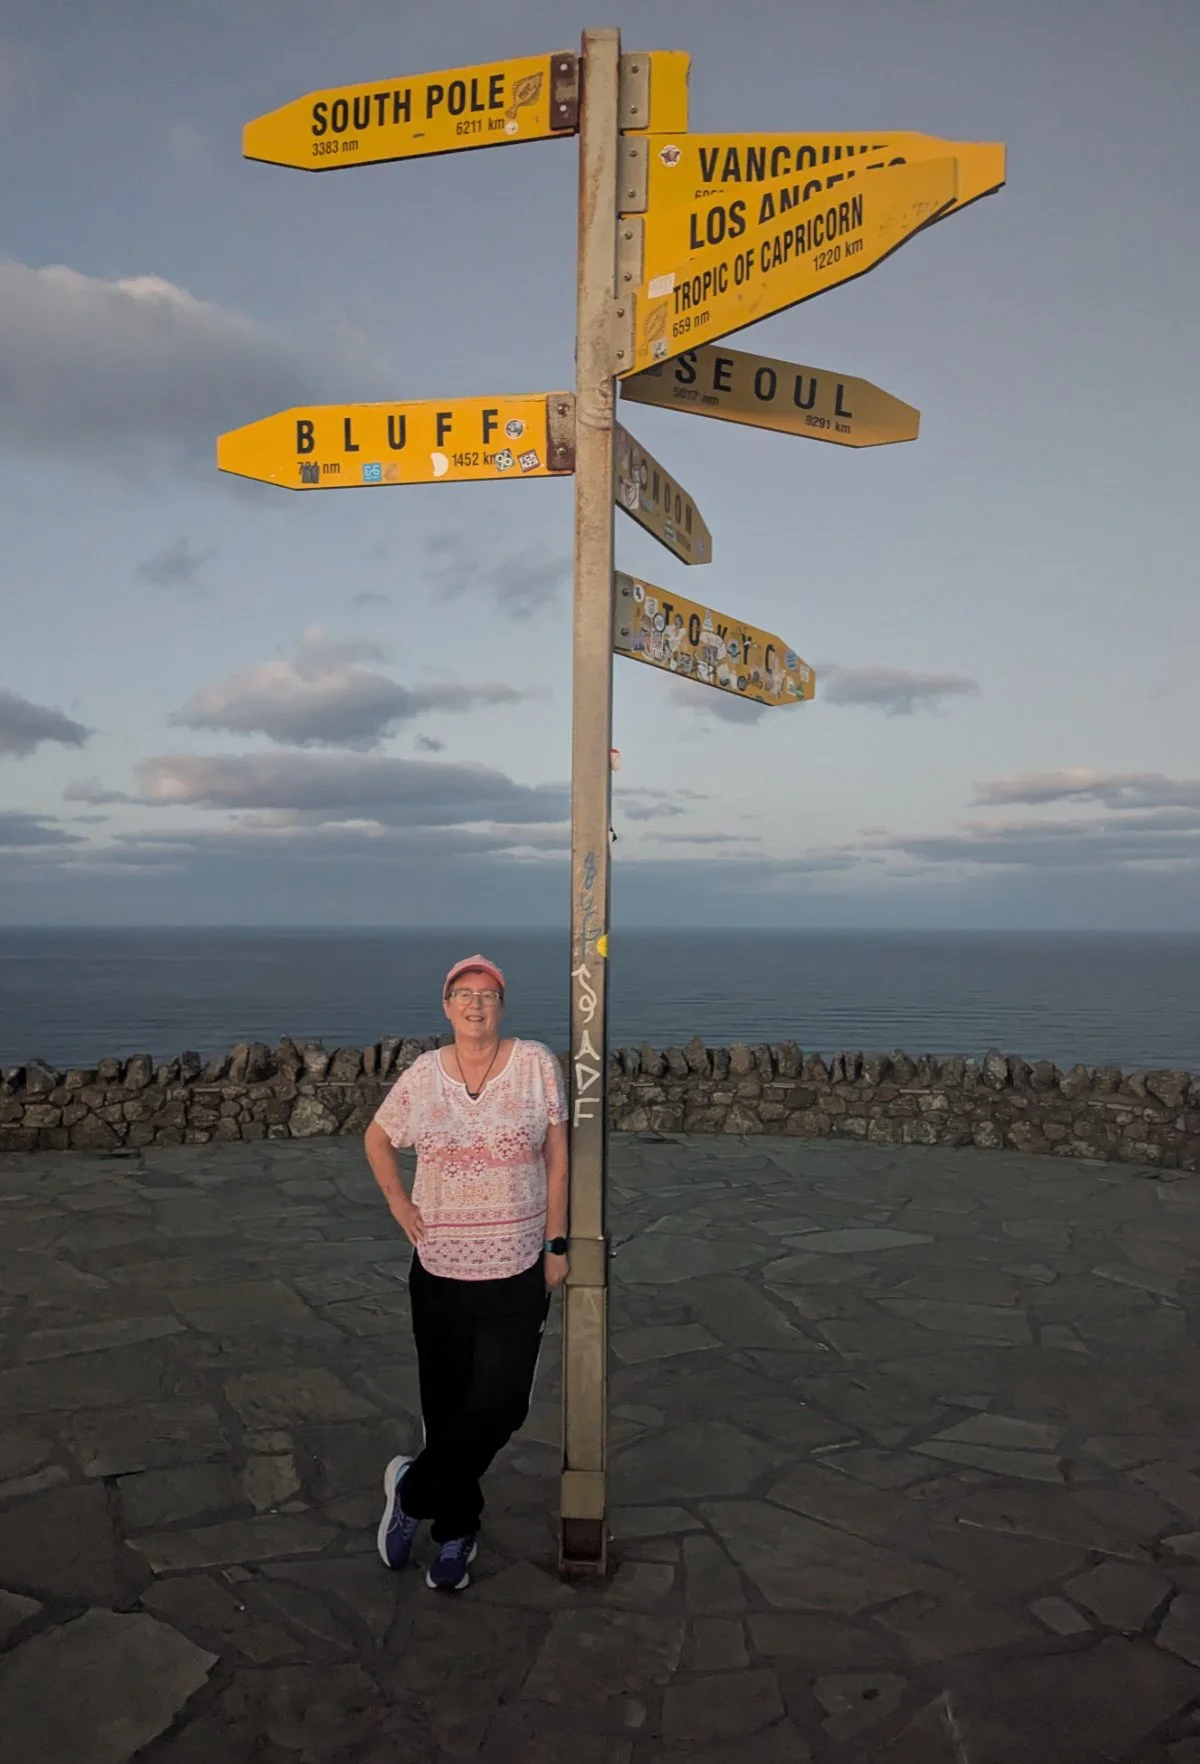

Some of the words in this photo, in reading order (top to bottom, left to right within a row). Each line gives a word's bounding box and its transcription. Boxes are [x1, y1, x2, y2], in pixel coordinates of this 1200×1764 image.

[312, 88, 411, 136] SOUTH
[426, 74, 505, 119] POLE
[456, 119, 482, 136] 6211
[488, 116, 505, 131] km
[312, 141, 339, 156] 3383
[342, 139, 359, 153] nm
[689, 200, 747, 250] LOS
[673, 261, 728, 315] TROPIC
[734, 248, 754, 285] OF
[760, 194, 863, 274] CAPRICORN
[812, 246, 841, 271] 1220
[845, 237, 863, 258] km
[672, 316, 691, 338] 659
[694, 310, 710, 328] nm
[674, 350, 853, 418] SEOUL
[296, 409, 499, 454] BLUFF
[805, 415, 831, 430] 9291
[835, 421, 851, 434] km
[322, 462, 341, 474] nm
[451, 452, 479, 467] 1452
